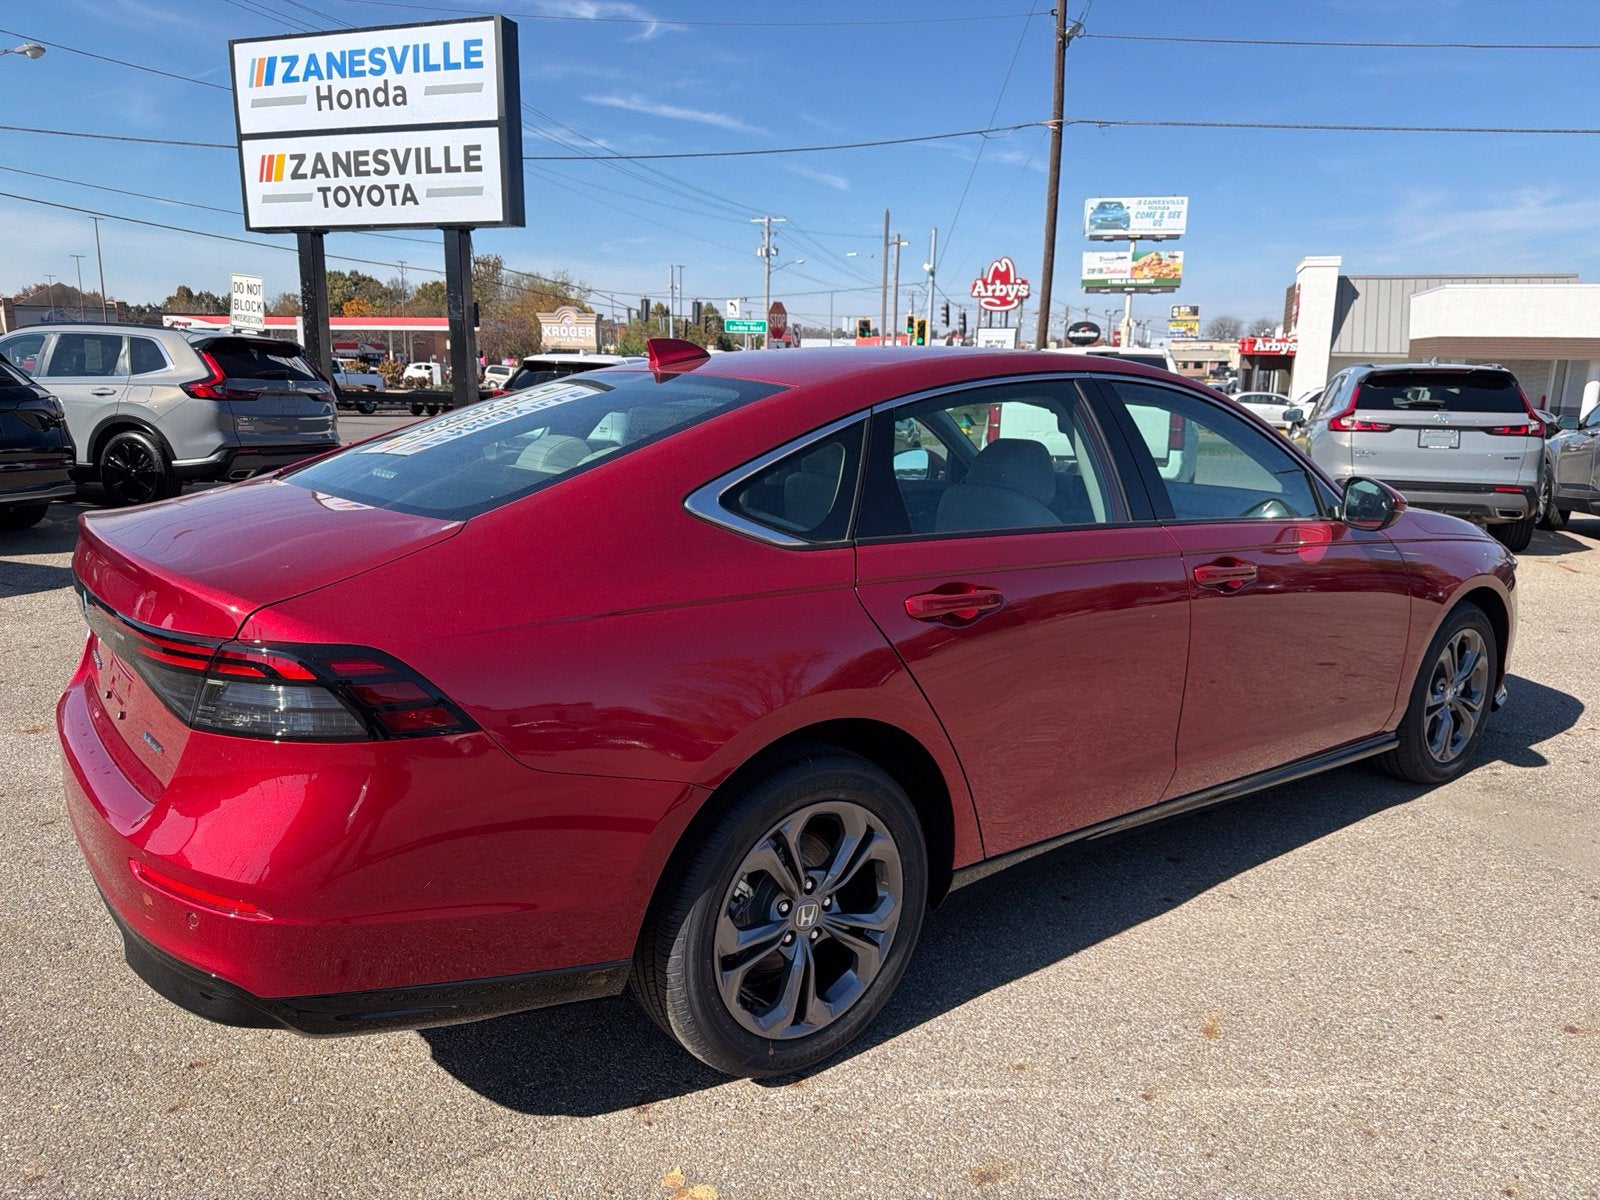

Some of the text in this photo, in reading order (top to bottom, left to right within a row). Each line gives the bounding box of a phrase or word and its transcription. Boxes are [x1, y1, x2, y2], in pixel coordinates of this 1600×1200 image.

[281, 38, 484, 84] ZANESVILLE
[316, 79, 408, 112] Honda
[289, 144, 483, 180] ZANESVILLE
[317, 183, 420, 209] TOYOTA
[1135, 211, 1157, 220] COME
[1168, 210, 1183, 219] SEE
[1152, 219, 1163, 227] US
[233, 281, 262, 296] DO NOT
[972, 279, 1029, 300] Arby's
[233, 298, 263, 313] BLOCK
[769, 313, 786, 328] STOP
[543, 326, 594, 337] KROGER
